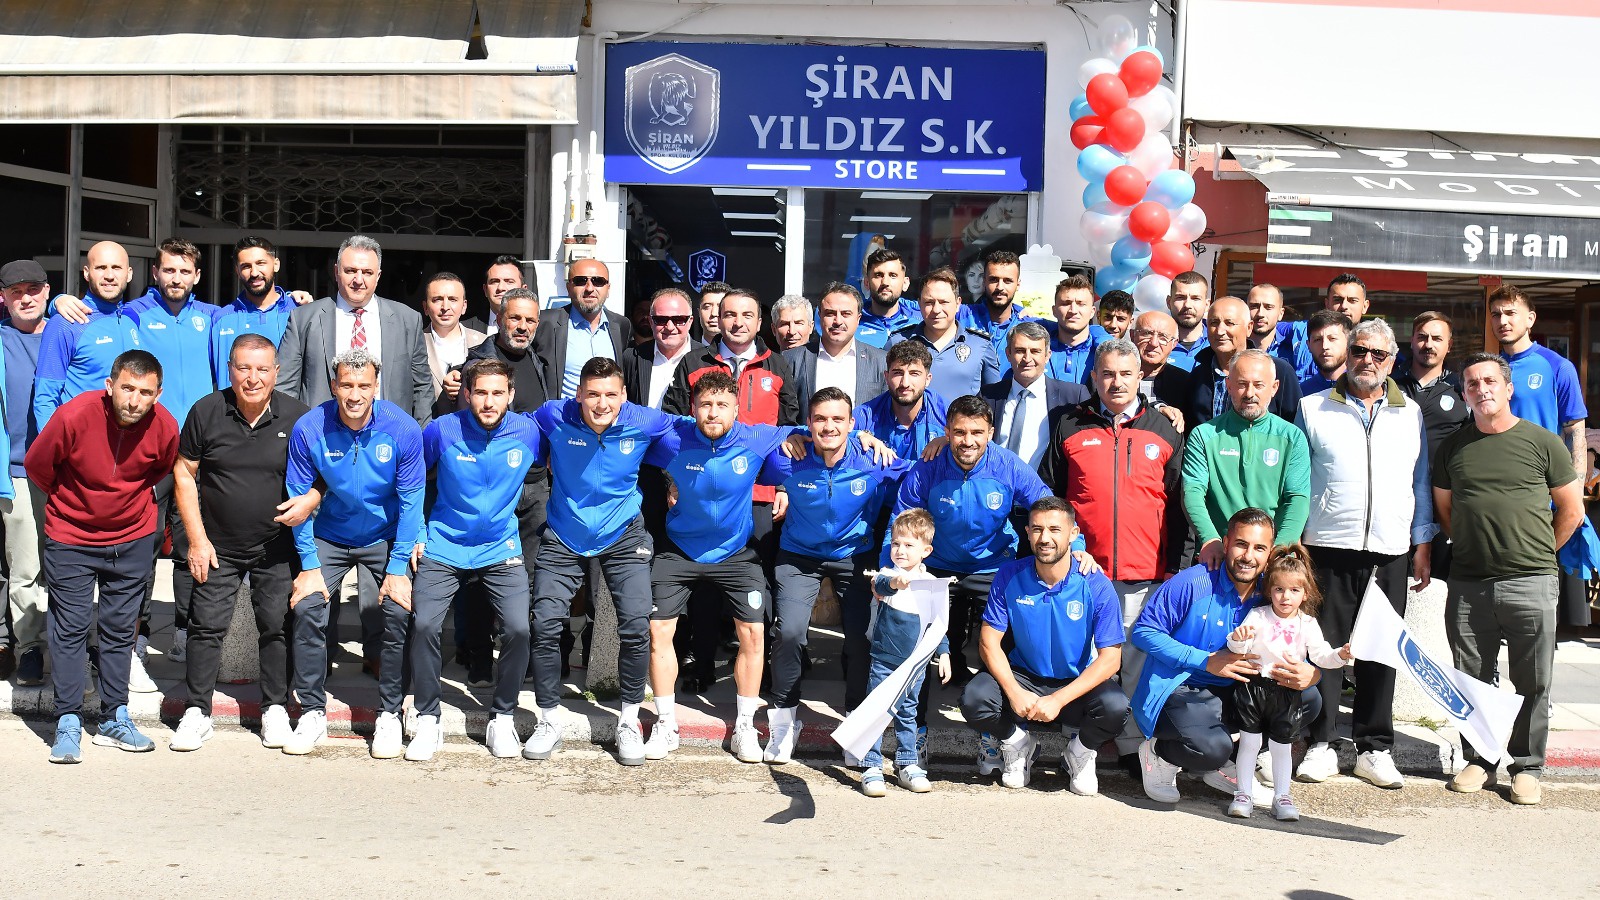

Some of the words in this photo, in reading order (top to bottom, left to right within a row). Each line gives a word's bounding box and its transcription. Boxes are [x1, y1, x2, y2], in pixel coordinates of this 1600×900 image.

[805, 55, 953, 108] ŞİRAN
[648, 130, 694, 146] ŞİRAN
[749, 115, 905, 152] YILDIZ
[921, 119, 1007, 155] S.K.
[834, 160, 918, 180] STORE
[1462, 224, 1568, 262] Şiran
